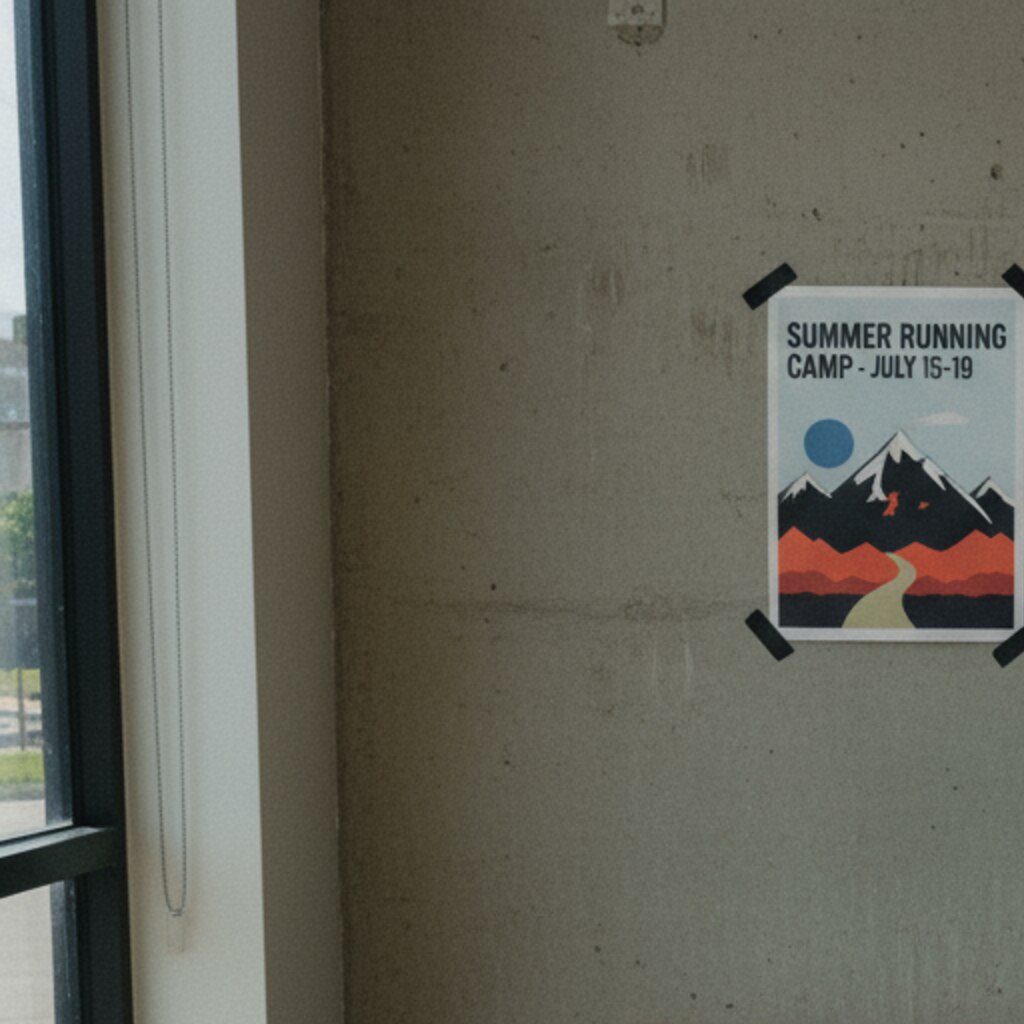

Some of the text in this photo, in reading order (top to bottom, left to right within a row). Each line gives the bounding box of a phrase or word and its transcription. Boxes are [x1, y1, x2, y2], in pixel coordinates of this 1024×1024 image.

[787, 321, 1007, 349] SUMMER RUNNING
[787, 353, 853, 379] CAMP
[870, 355, 916, 379] JULY
